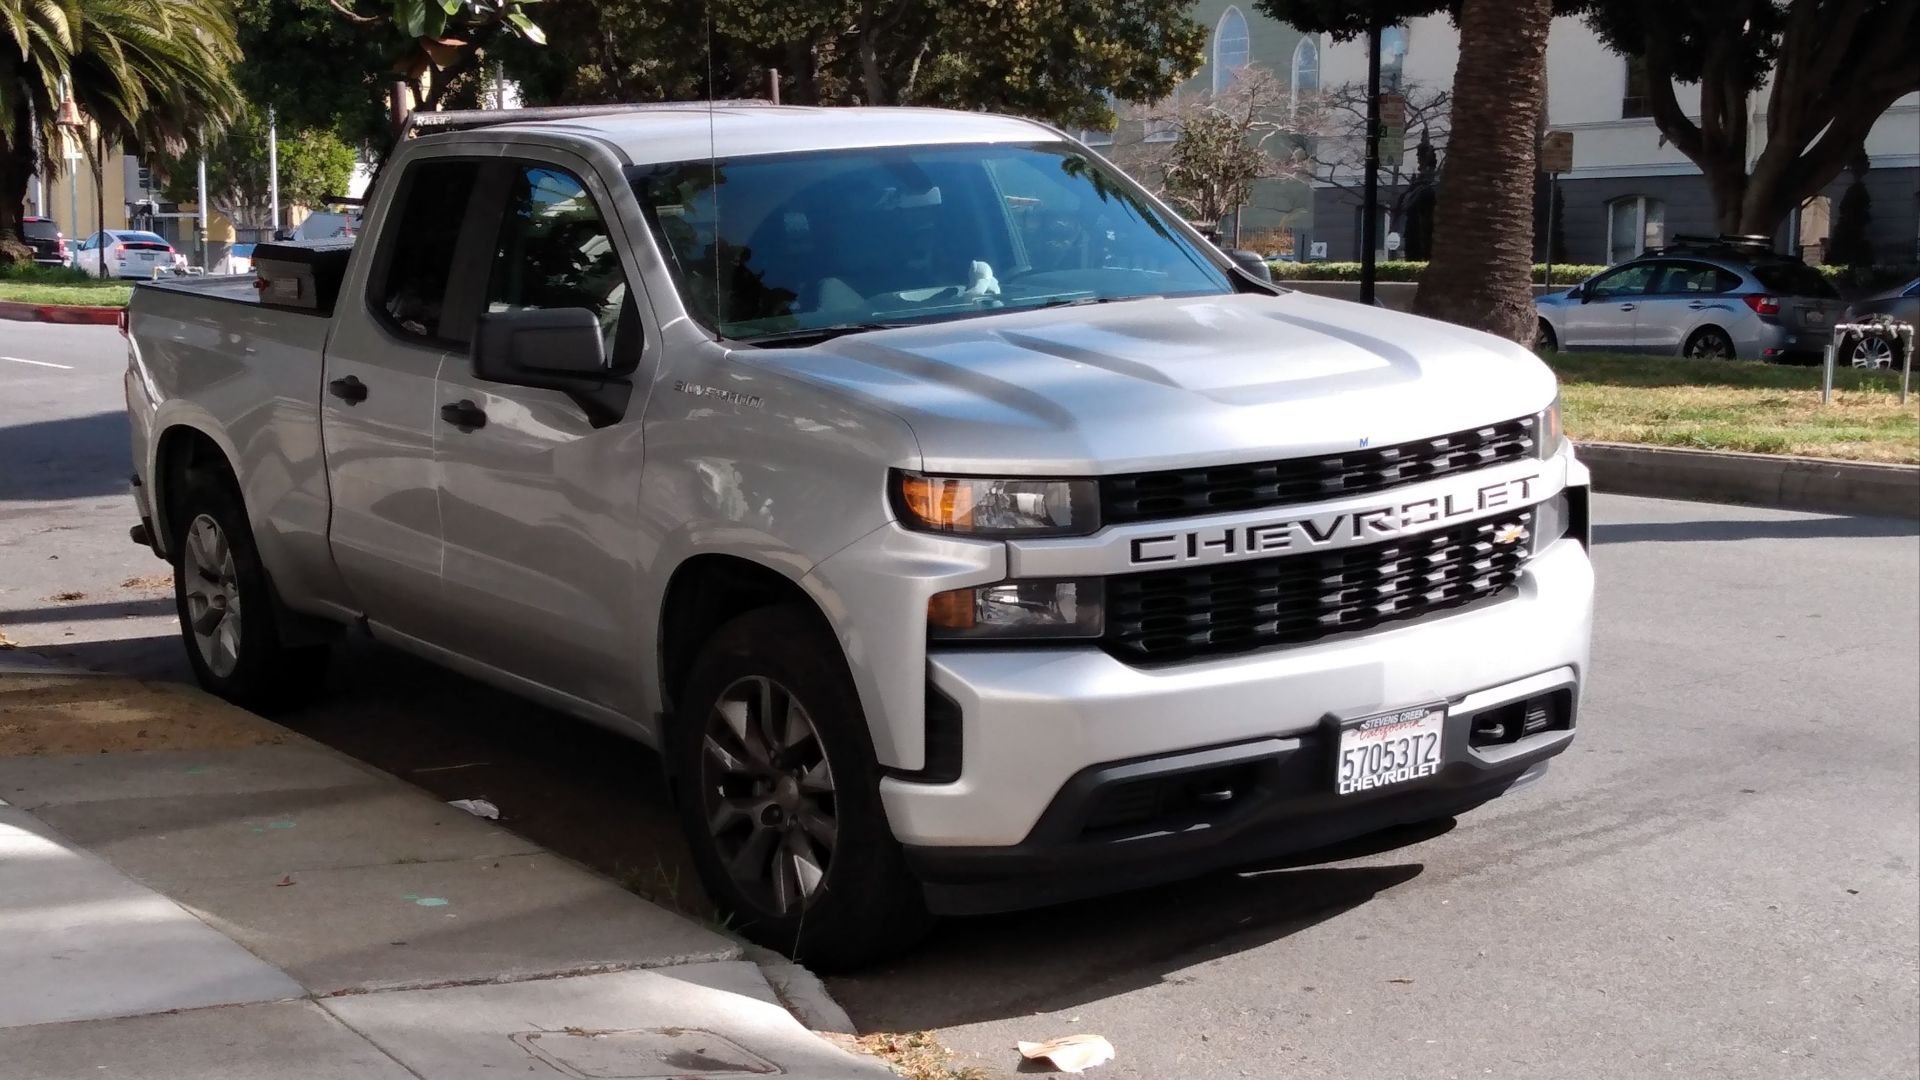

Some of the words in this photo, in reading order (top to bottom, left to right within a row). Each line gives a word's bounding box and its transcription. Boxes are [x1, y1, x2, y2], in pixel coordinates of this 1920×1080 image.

[1129, 475, 1540, 566] CHEVROLET
[1364, 715, 1399, 730] STEVENS
[1400, 709, 1425, 722] CREEK
[1339, 759, 1441, 794] CHEVROLET
[1343, 732, 1437, 781] 57053T2
